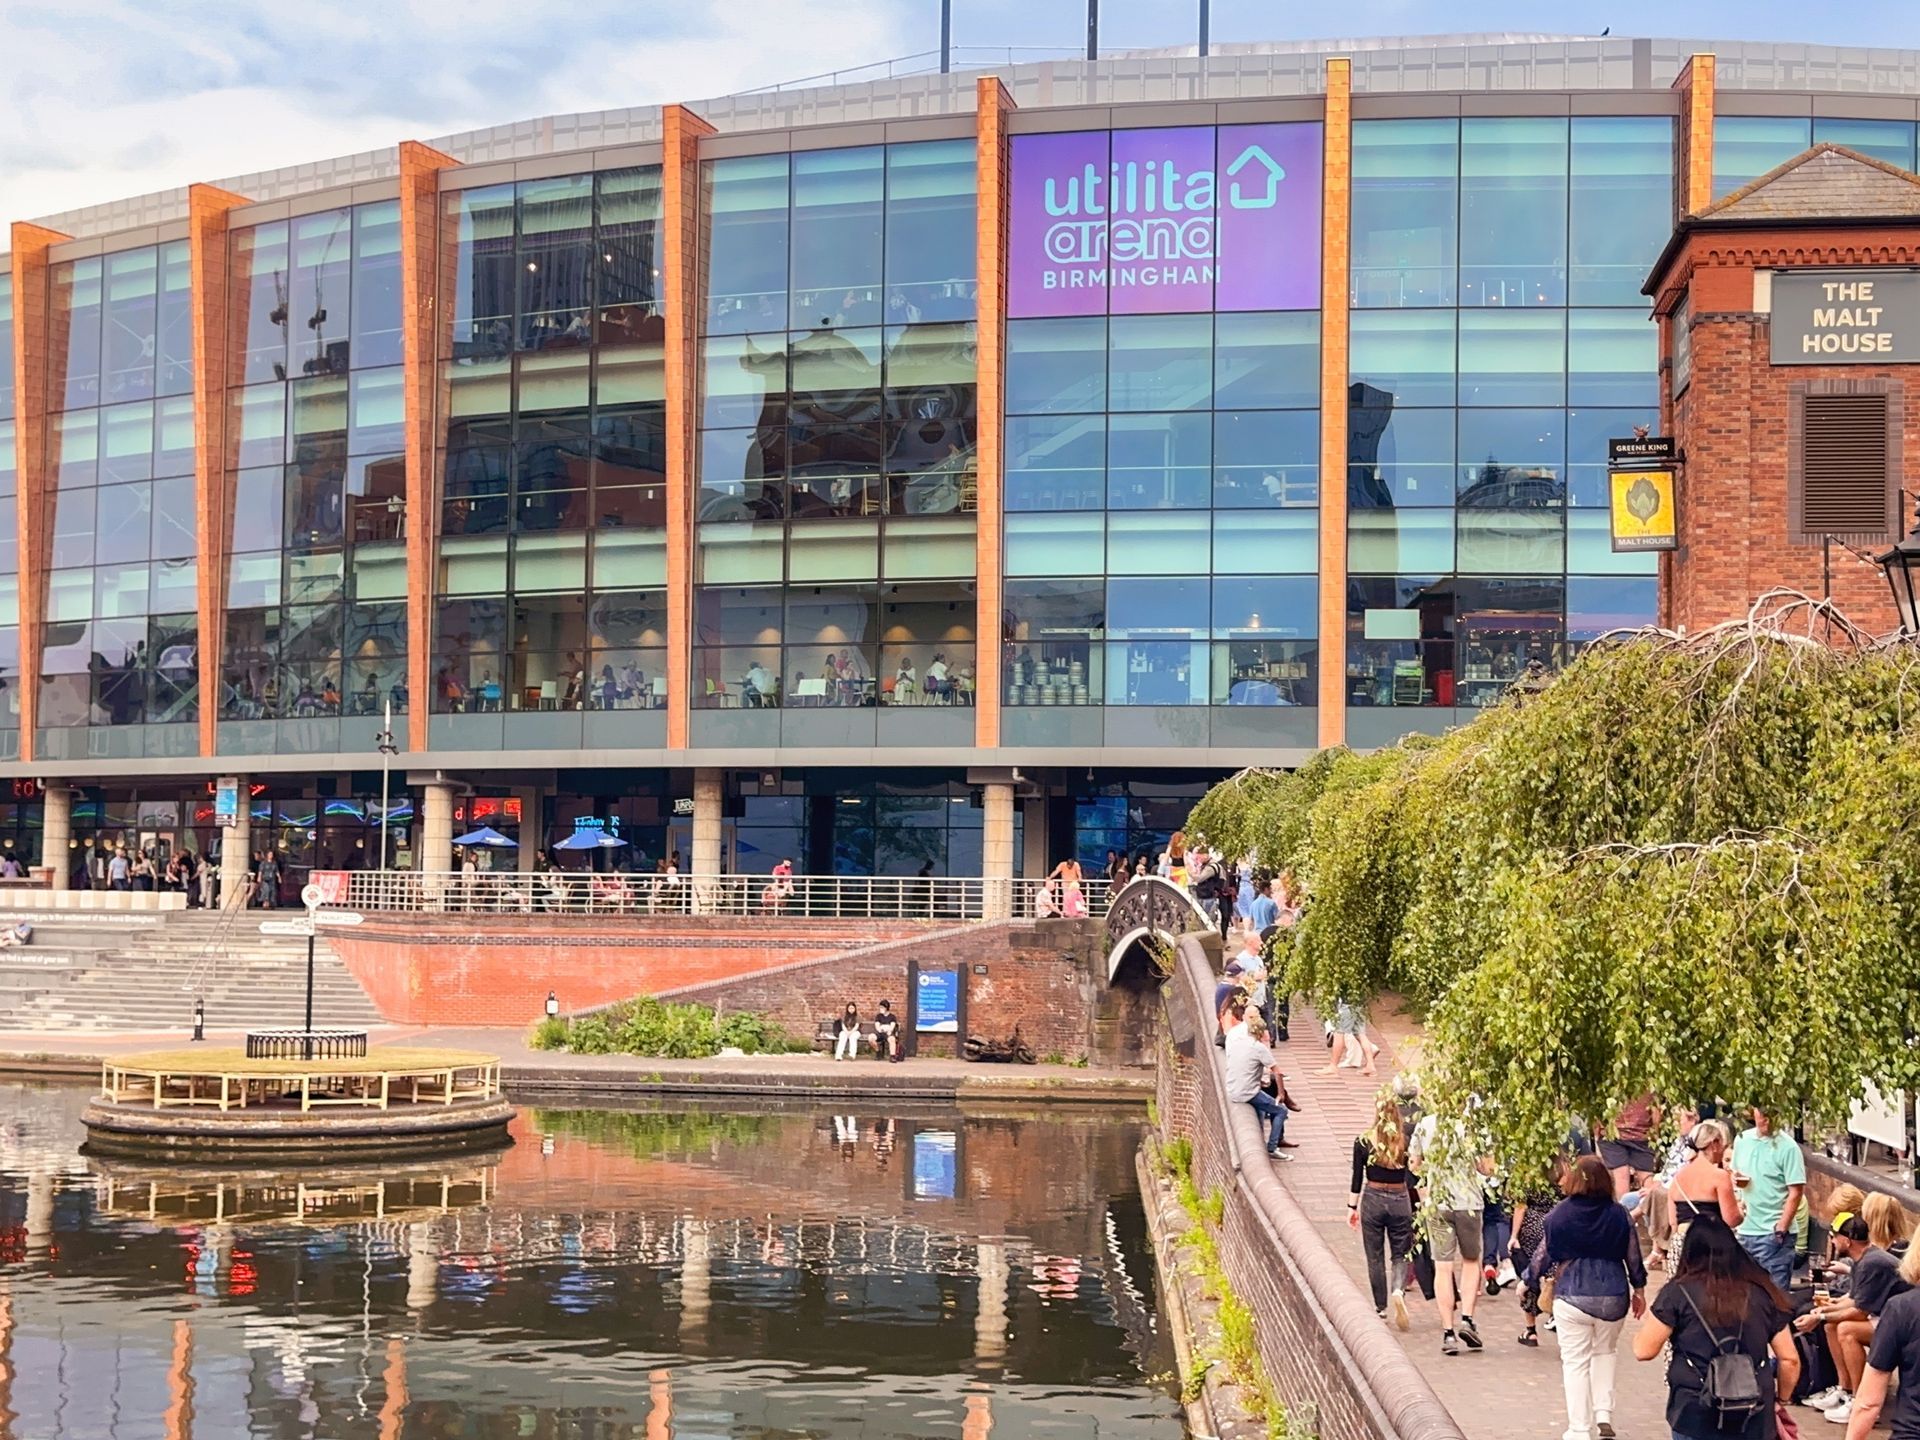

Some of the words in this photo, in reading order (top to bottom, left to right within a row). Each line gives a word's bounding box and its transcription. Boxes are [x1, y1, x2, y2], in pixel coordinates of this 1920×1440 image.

[1045, 160, 1221, 216] utilita
[1044, 217, 1221, 264] arena
[1043, 265, 1221, 289] BIRMINGHAM
[1822, 282, 1874, 301] THE
[1813, 307, 1883, 327] MALT
[1803, 333, 1893, 353] HOUSE
[1642, 537, 1671, 545] HOUSE
